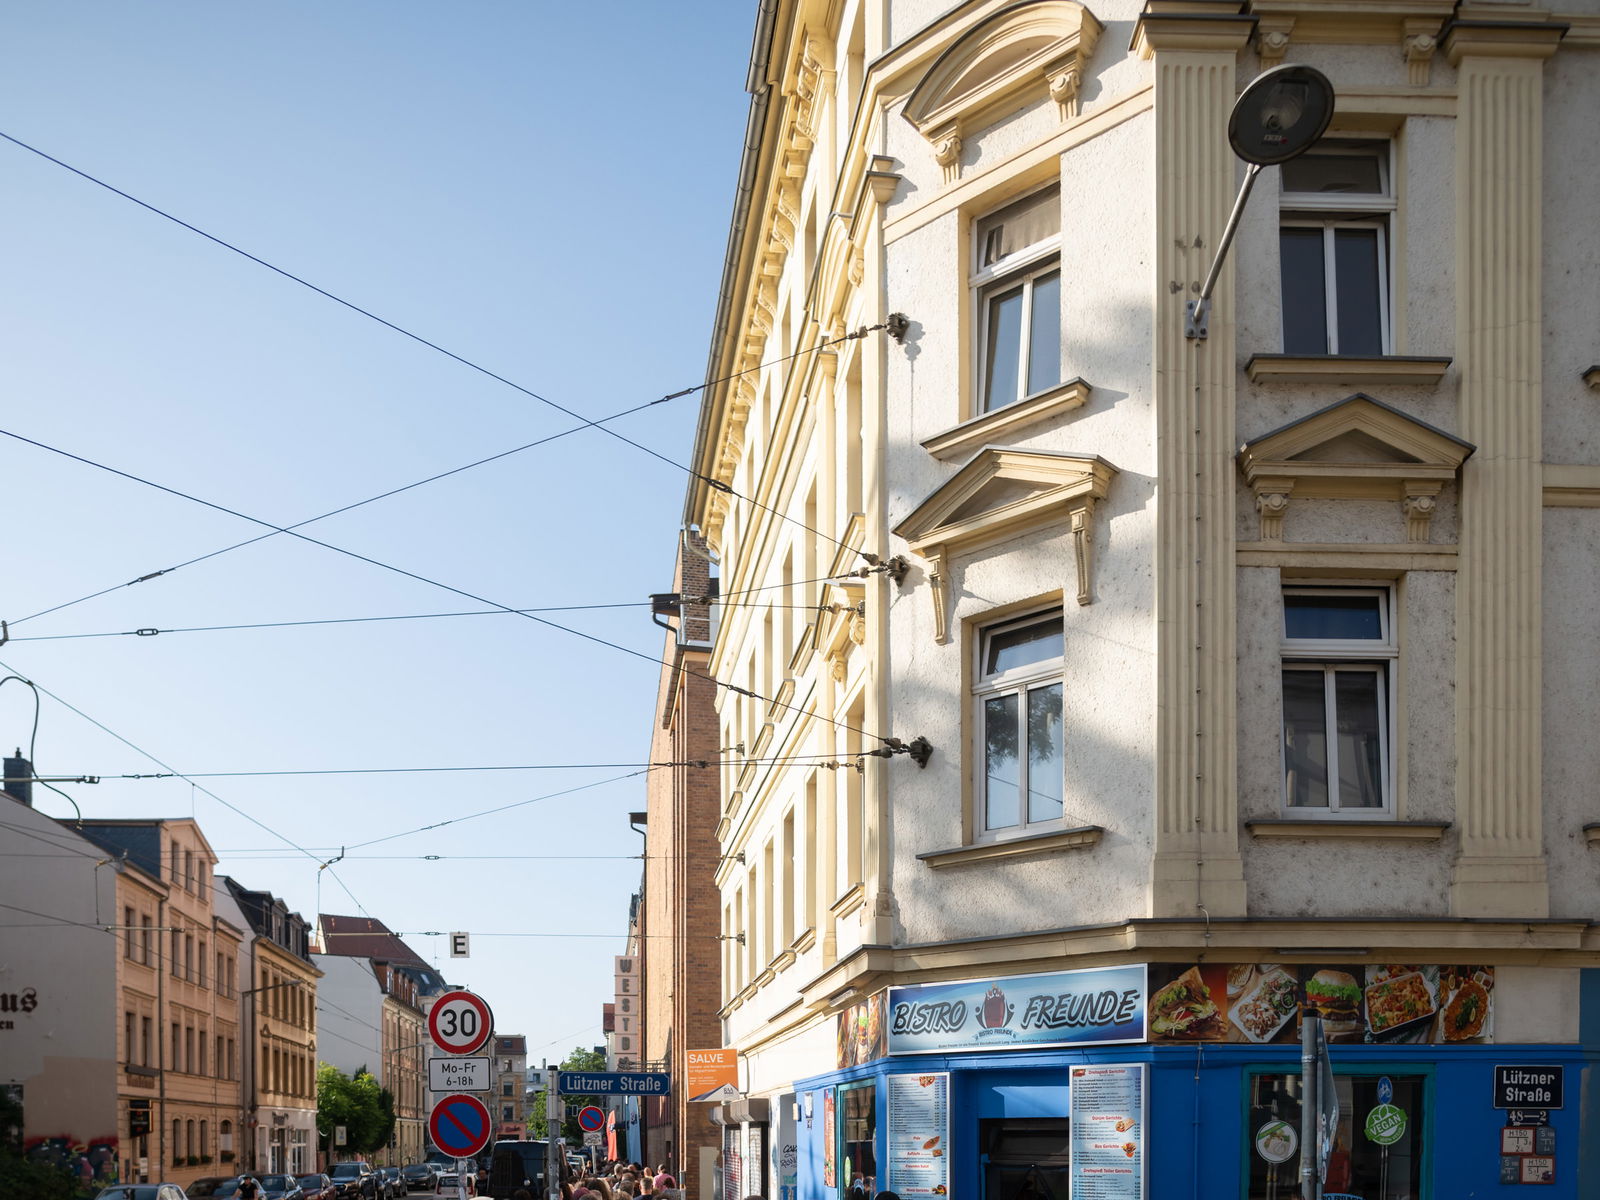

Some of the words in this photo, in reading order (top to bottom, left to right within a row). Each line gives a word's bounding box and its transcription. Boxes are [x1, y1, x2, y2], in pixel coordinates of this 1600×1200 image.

[453, 935, 467, 955] E
[892, 999, 968, 1035] BISTRO
[1020, 989, 1140, 1029] FREUNDE
[441, 1009, 476, 1037] 30
[689, 1053, 724, 1064] SALVE
[441, 1063, 476, 1073] Mo-Fr
[446, 1076, 473, 1086] 6-18h
[567, 1075, 614, 1091] Lützner
[620, 1076, 661, 1091] Straße
[1503, 1070, 1555, 1085] Lützner
[1506, 1087, 1551, 1102] Straße
[1370, 1114, 1401, 1135] VEGAN
